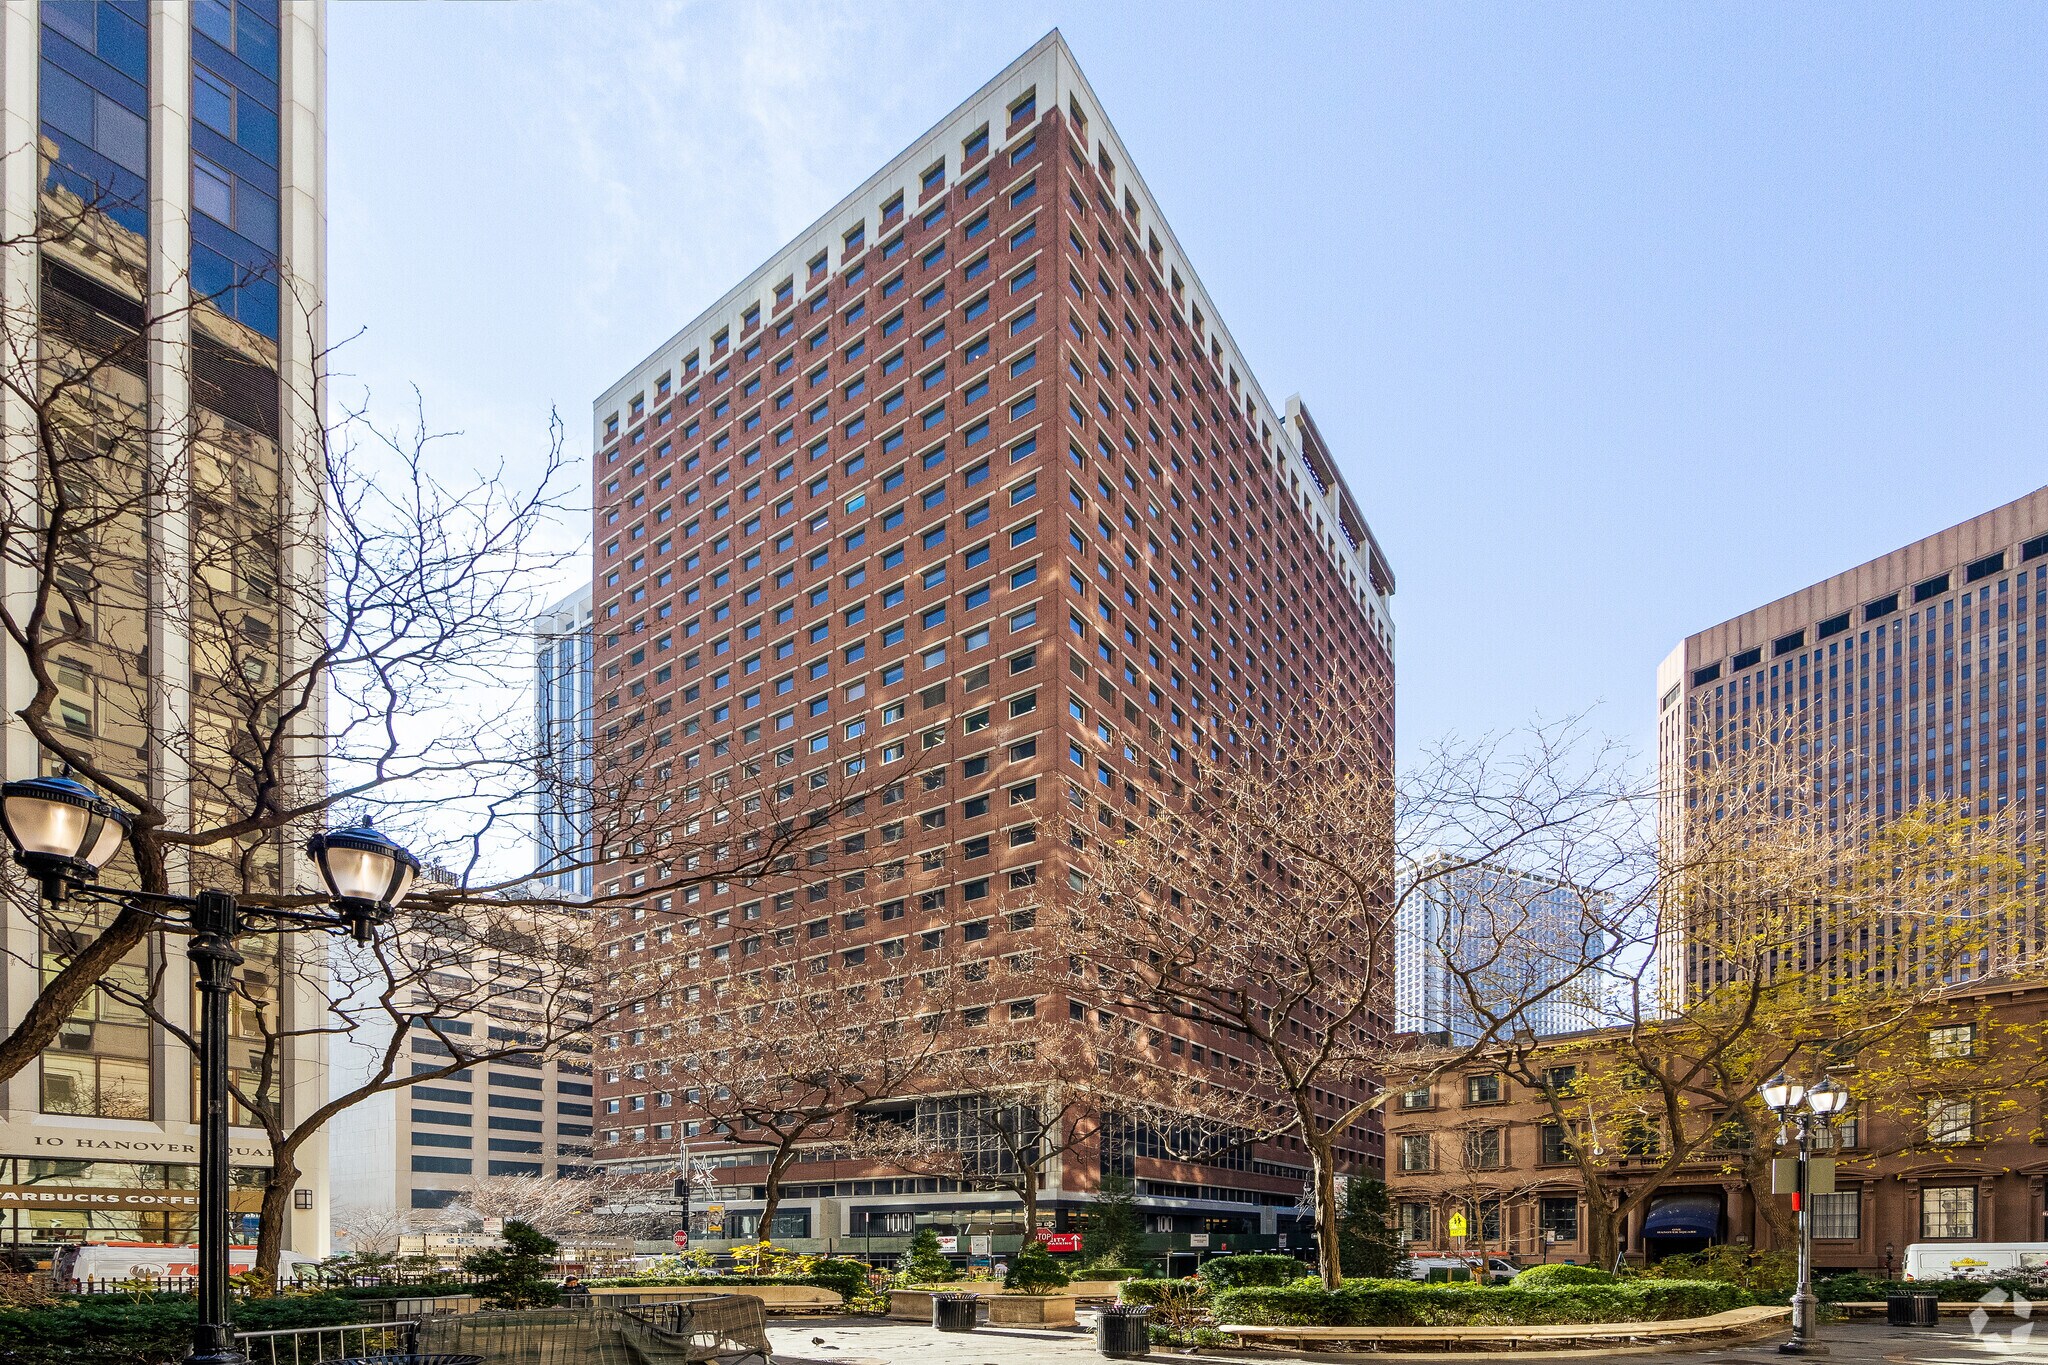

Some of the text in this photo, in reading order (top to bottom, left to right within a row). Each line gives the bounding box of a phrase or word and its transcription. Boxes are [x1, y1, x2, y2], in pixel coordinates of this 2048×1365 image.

[76, 1139, 196, 1153] HANOVER
[0, 1192, 199, 1205] ARBUCKS COFFE
[1157, 1216, 1173, 1232] 100
